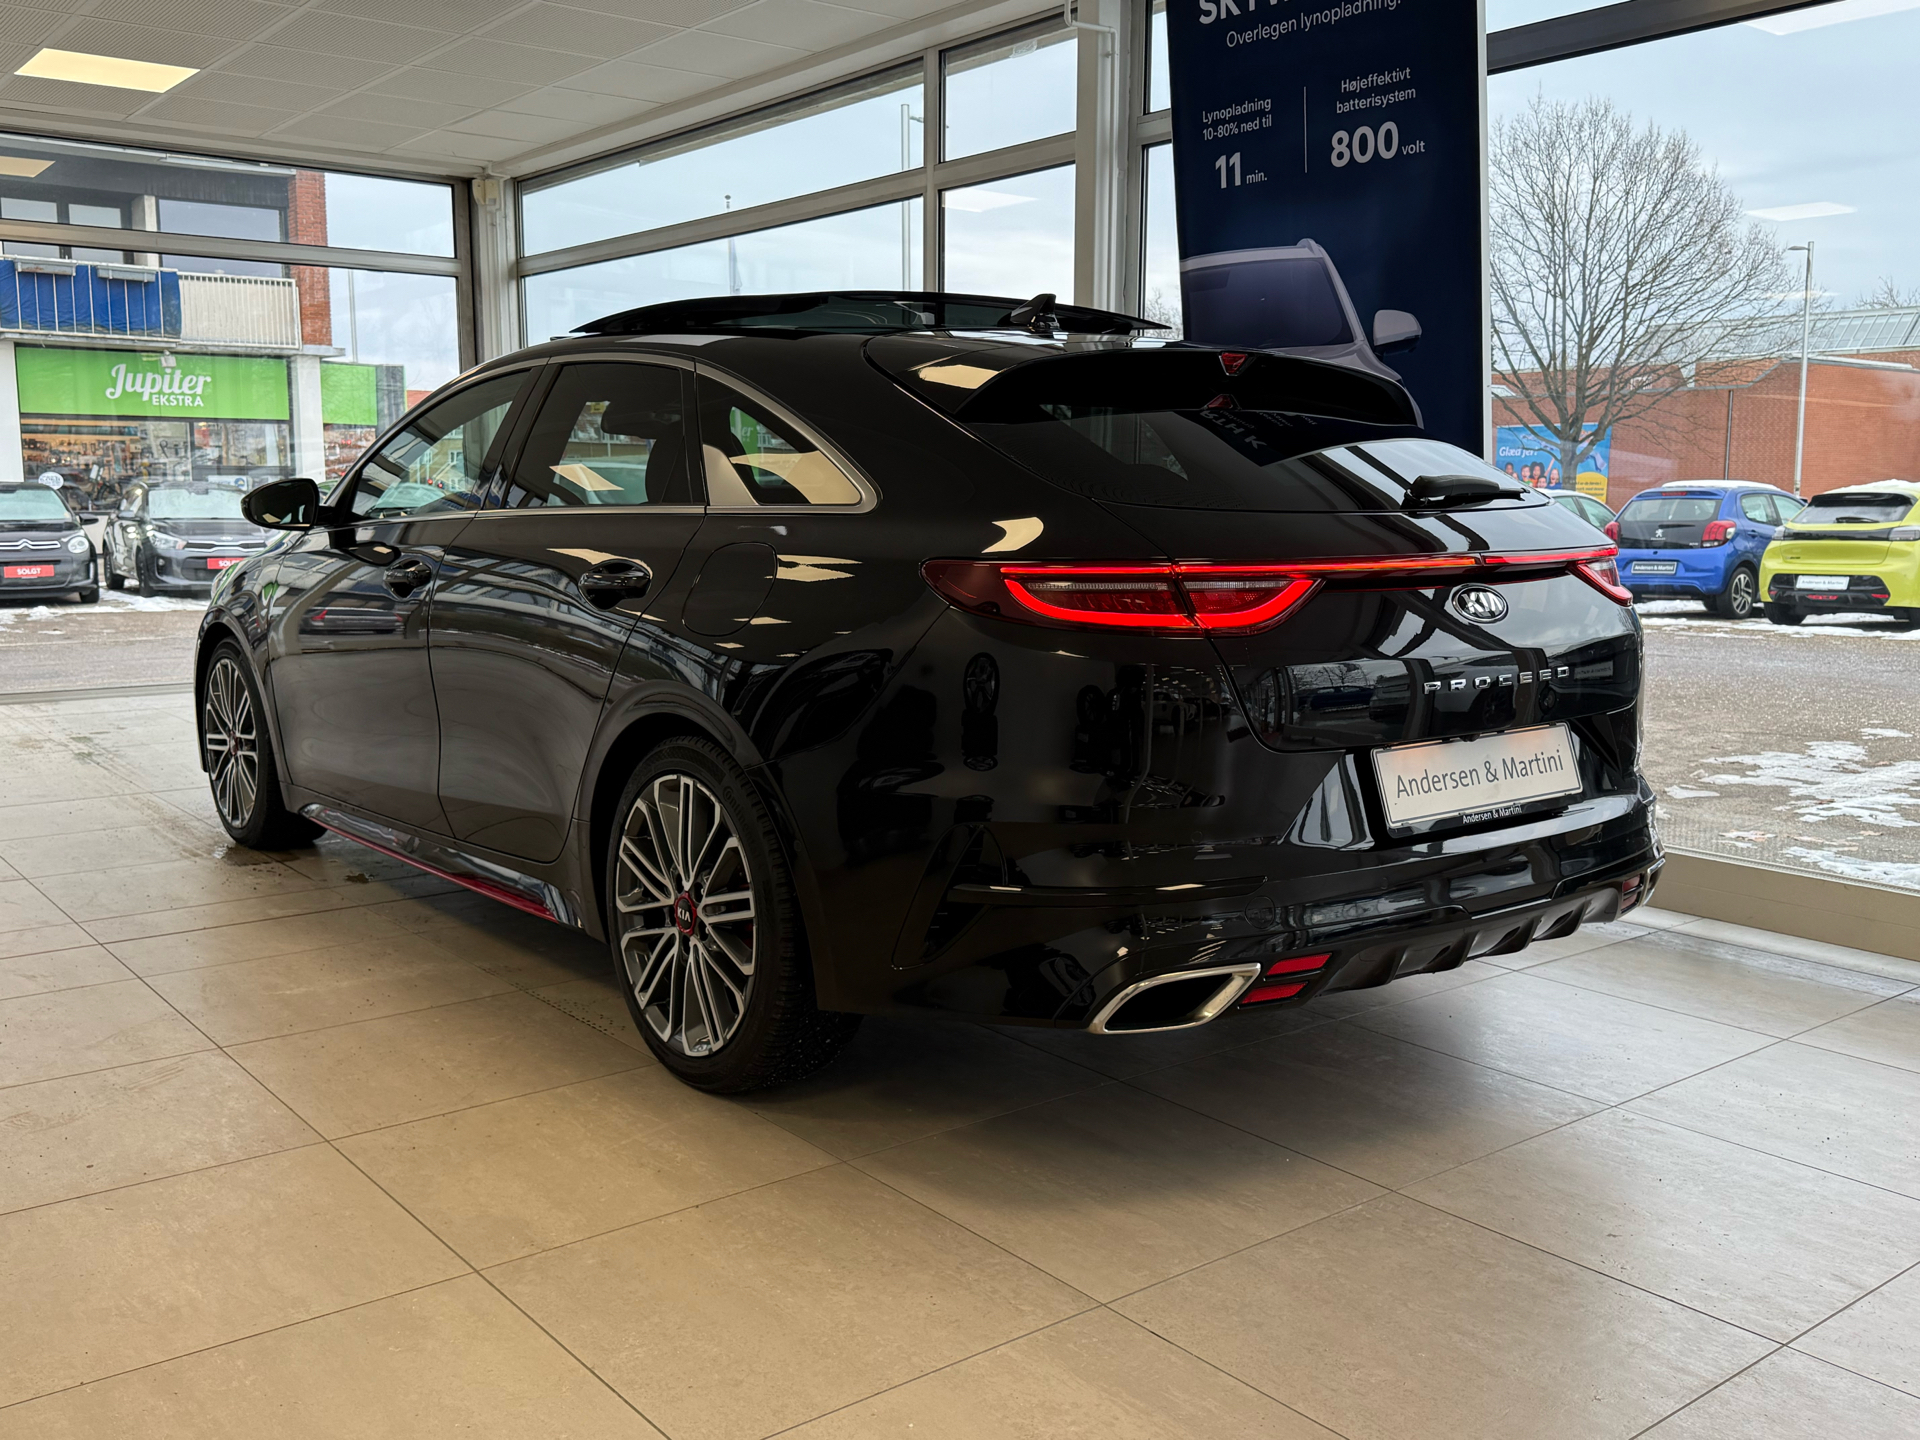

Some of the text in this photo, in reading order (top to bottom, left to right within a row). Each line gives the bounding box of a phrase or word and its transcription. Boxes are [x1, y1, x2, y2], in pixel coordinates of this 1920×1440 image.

[1226, 18, 1297, 48] Overlegen
[1341, 67, 1411, 93] Højeffektivt
[1202, 98, 1272, 125] Lynopladning
[1336, 87, 1416, 114] batterisystem
[1202, 114, 1272, 141] 10-80% ned til
[1330, 121, 1426, 168] 800 volt
[1215, 151, 1268, 189] 11 min.
[105, 363, 212, 402] Jupiter
[152, 394, 204, 407] EKSTRA
[17, 567, 42, 576] SOLGT
[1423, 666, 1569, 694] PROCEED
[1397, 749, 1564, 799] Andersen & Martini
[1462, 803, 1523, 825] Andersen & Martini
[677, 906, 691, 923] KIA
